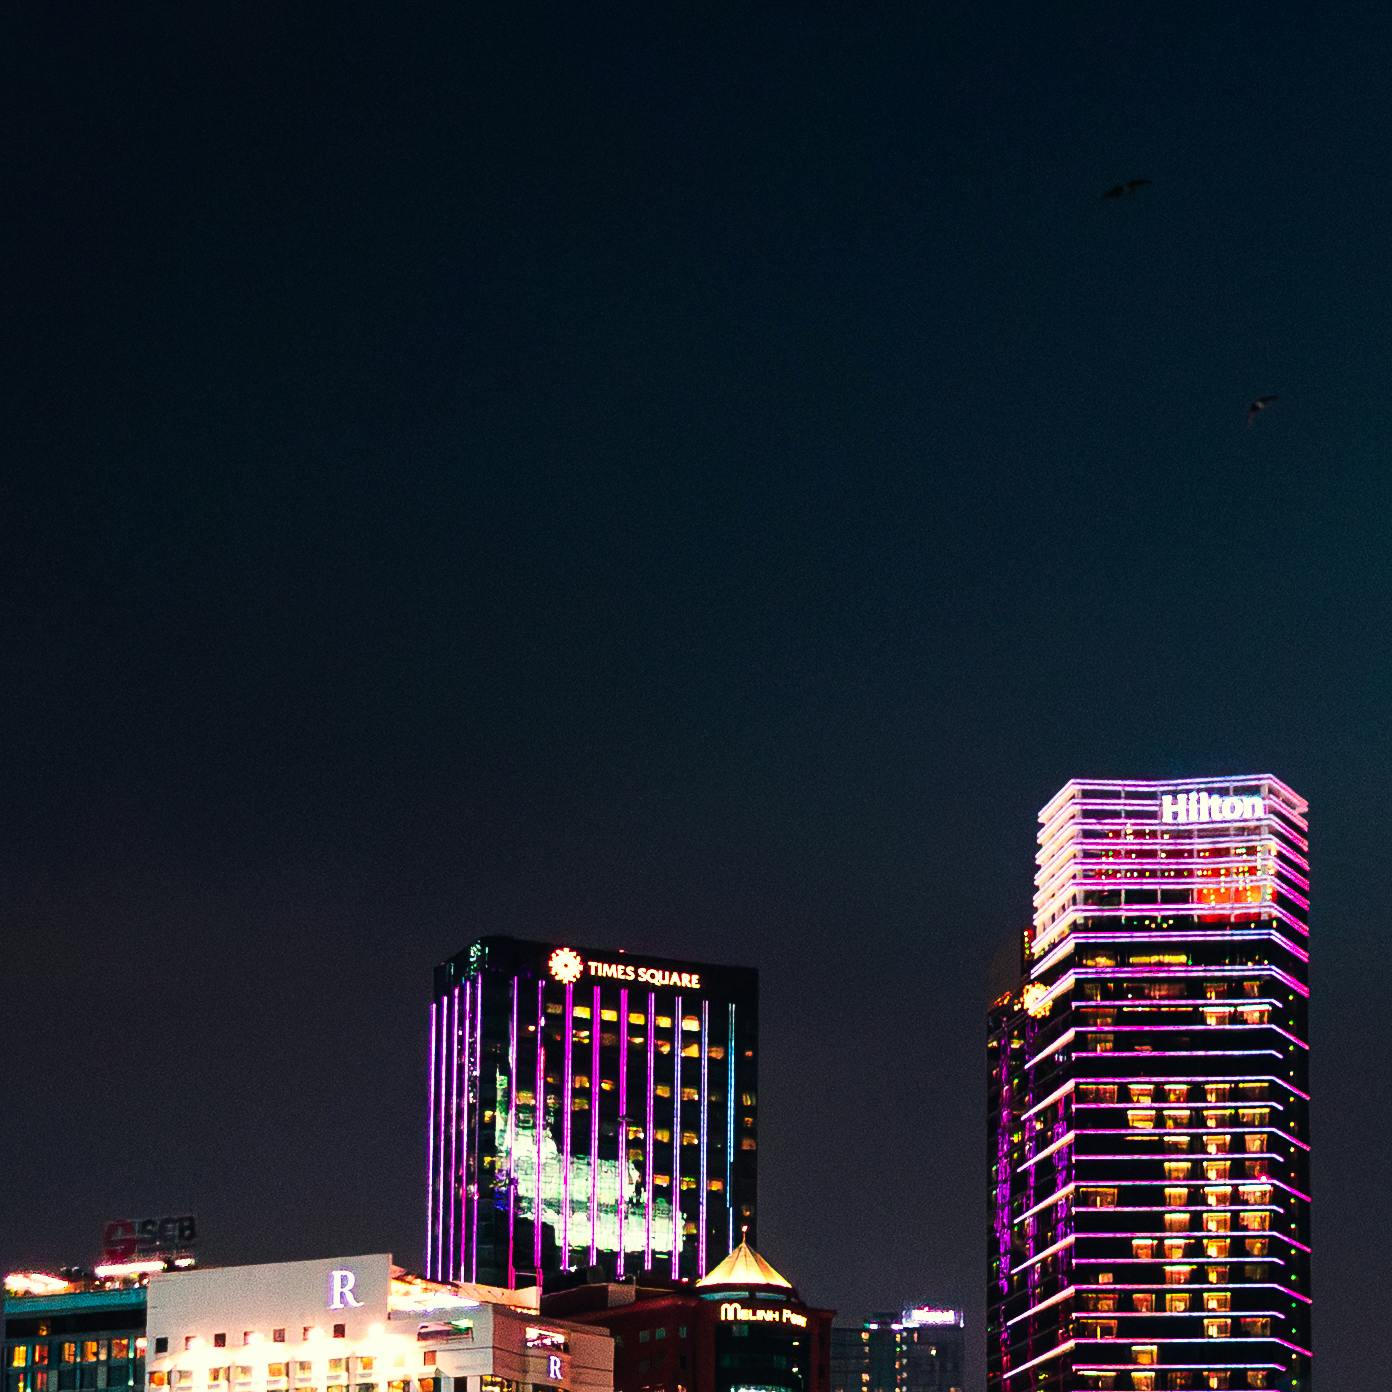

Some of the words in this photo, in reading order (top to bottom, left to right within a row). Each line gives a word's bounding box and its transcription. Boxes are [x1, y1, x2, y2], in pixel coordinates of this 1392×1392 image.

[1161, 791, 1264, 823] Hilton
[587, 961, 635, 981] TIMES
[637, 967, 701, 989] SQUARE
[328, 1270, 365, 1310] R
[548, 1356, 563, 1380] R
